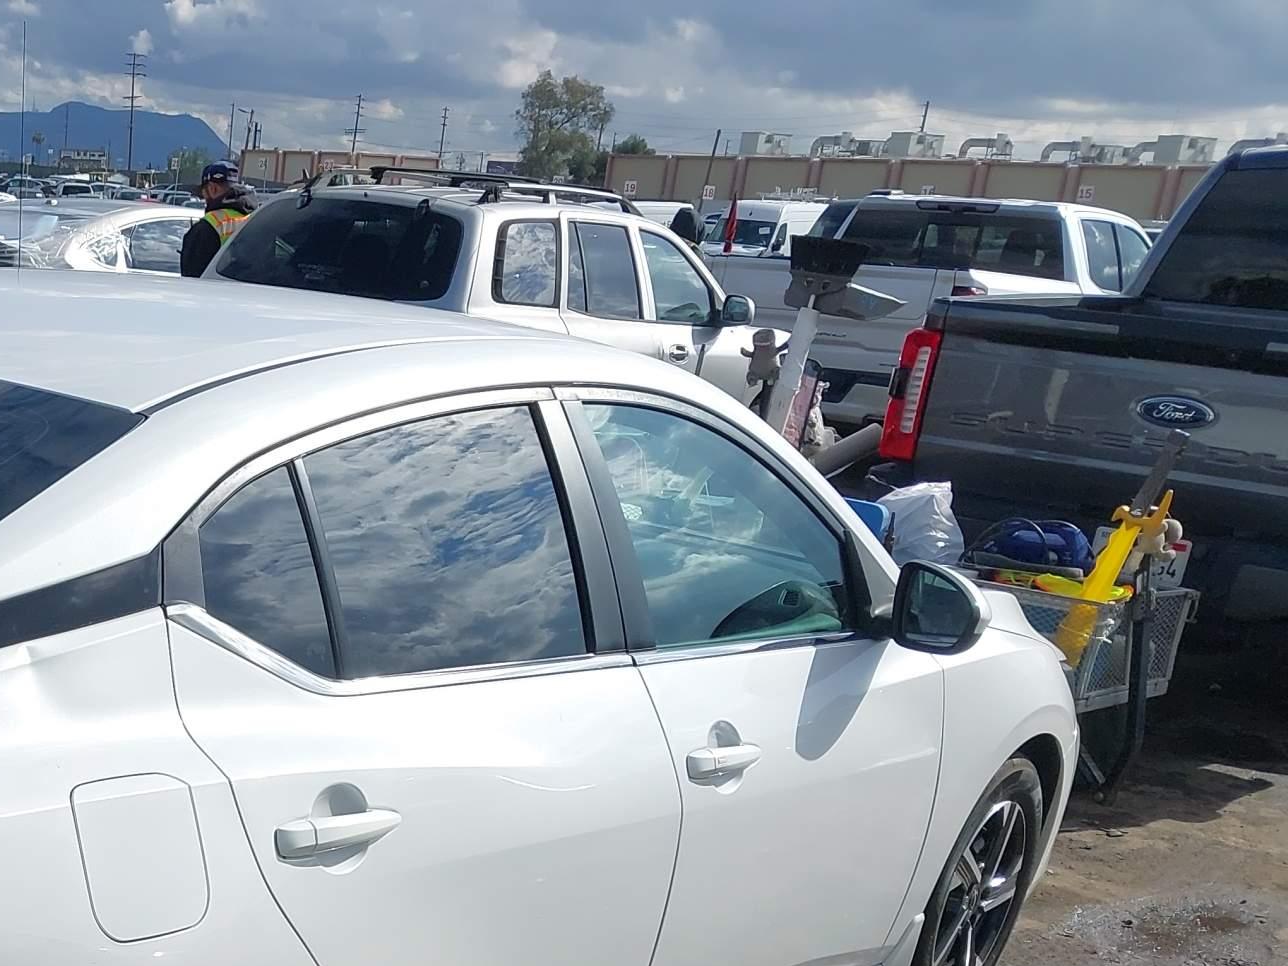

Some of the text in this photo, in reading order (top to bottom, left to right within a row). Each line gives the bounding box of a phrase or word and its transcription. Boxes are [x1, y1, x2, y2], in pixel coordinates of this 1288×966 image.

[625, 183, 636, 193] 19
[1079, 188, 1092, 199] 15
[1152, 401, 1196, 422] Ford
